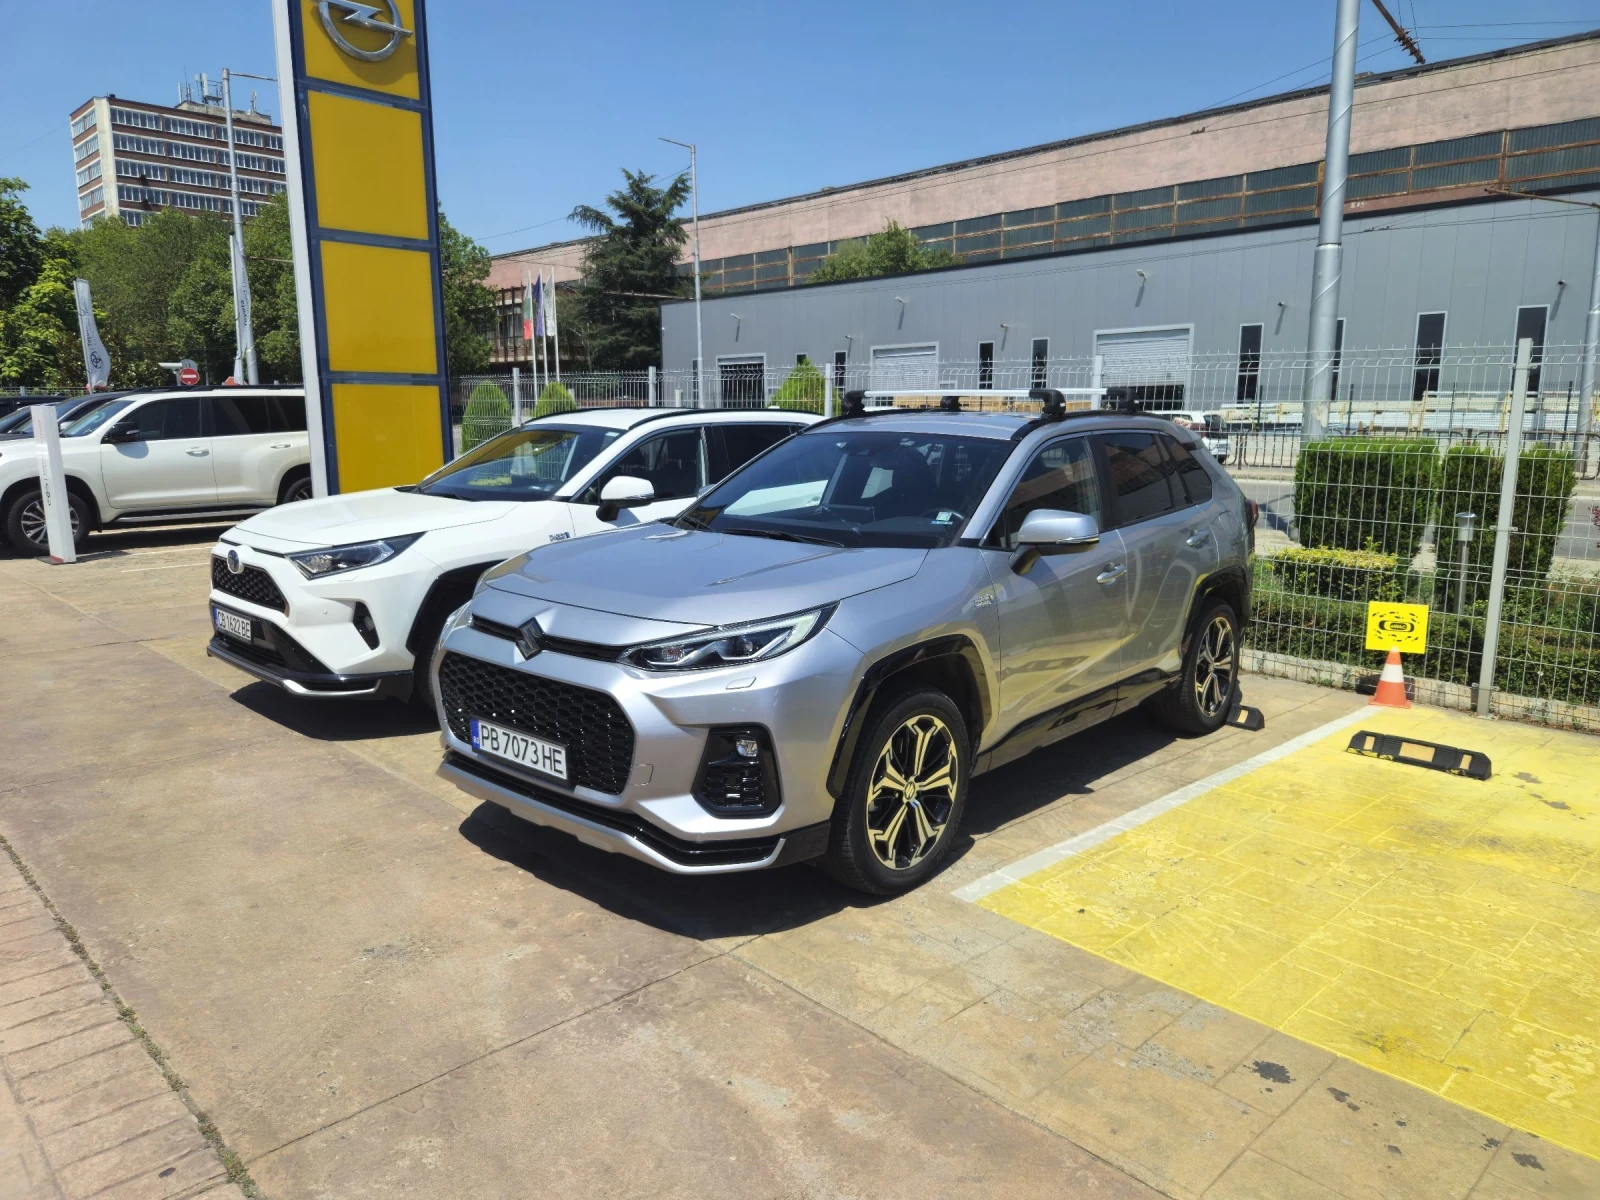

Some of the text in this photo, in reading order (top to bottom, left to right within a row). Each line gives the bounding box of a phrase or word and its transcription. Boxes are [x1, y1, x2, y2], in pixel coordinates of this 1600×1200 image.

[241, 620, 250, 639] BE
[481, 724, 563, 774] PB 7073 HE
